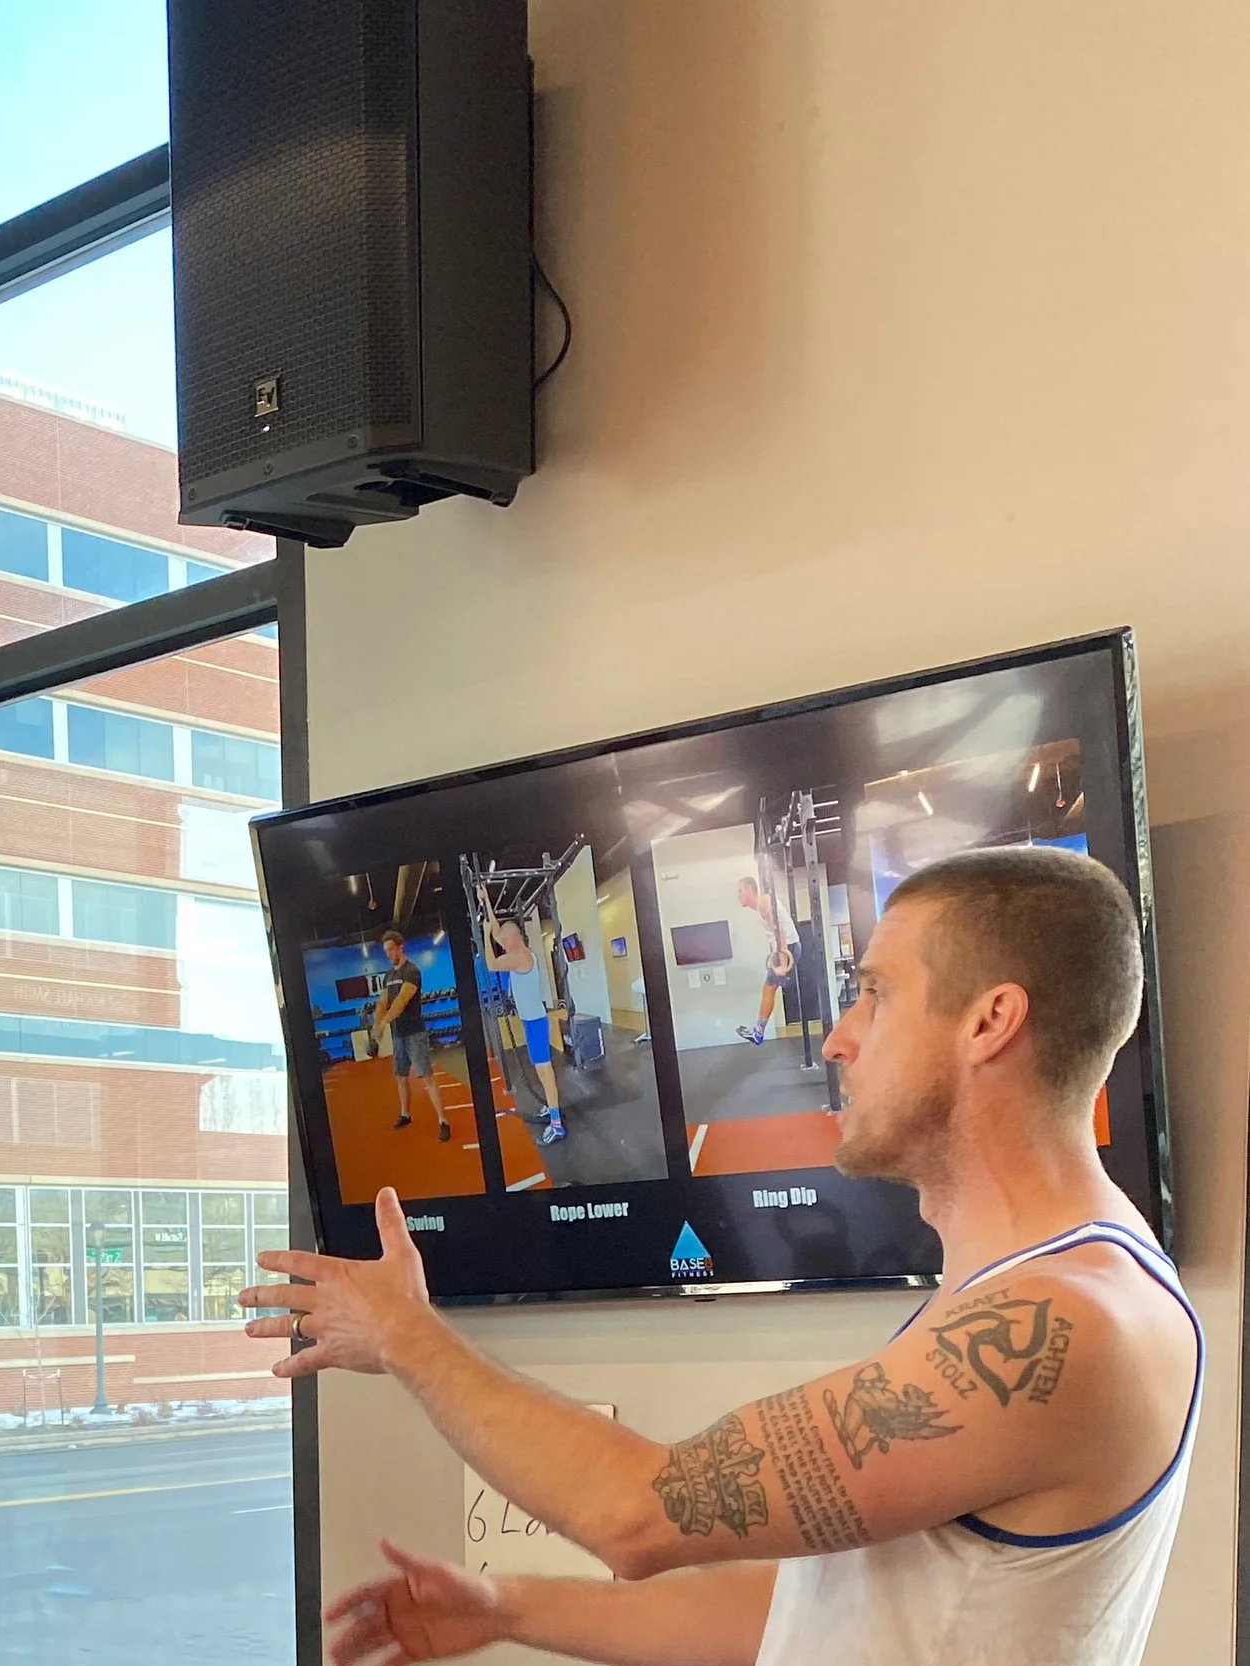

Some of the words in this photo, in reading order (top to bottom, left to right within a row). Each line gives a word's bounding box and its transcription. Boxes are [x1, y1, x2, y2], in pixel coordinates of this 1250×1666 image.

[752, 1189, 789, 1208] Ring
[790, 1187, 817, 1206] Dip
[550, 1205, 586, 1222] Rope
[587, 1202, 629, 1219] Lower
[406, 1215, 445, 1231] Swing
[925, 1348, 978, 1400] STOLZ
[467, 1489, 487, 1542] 6
